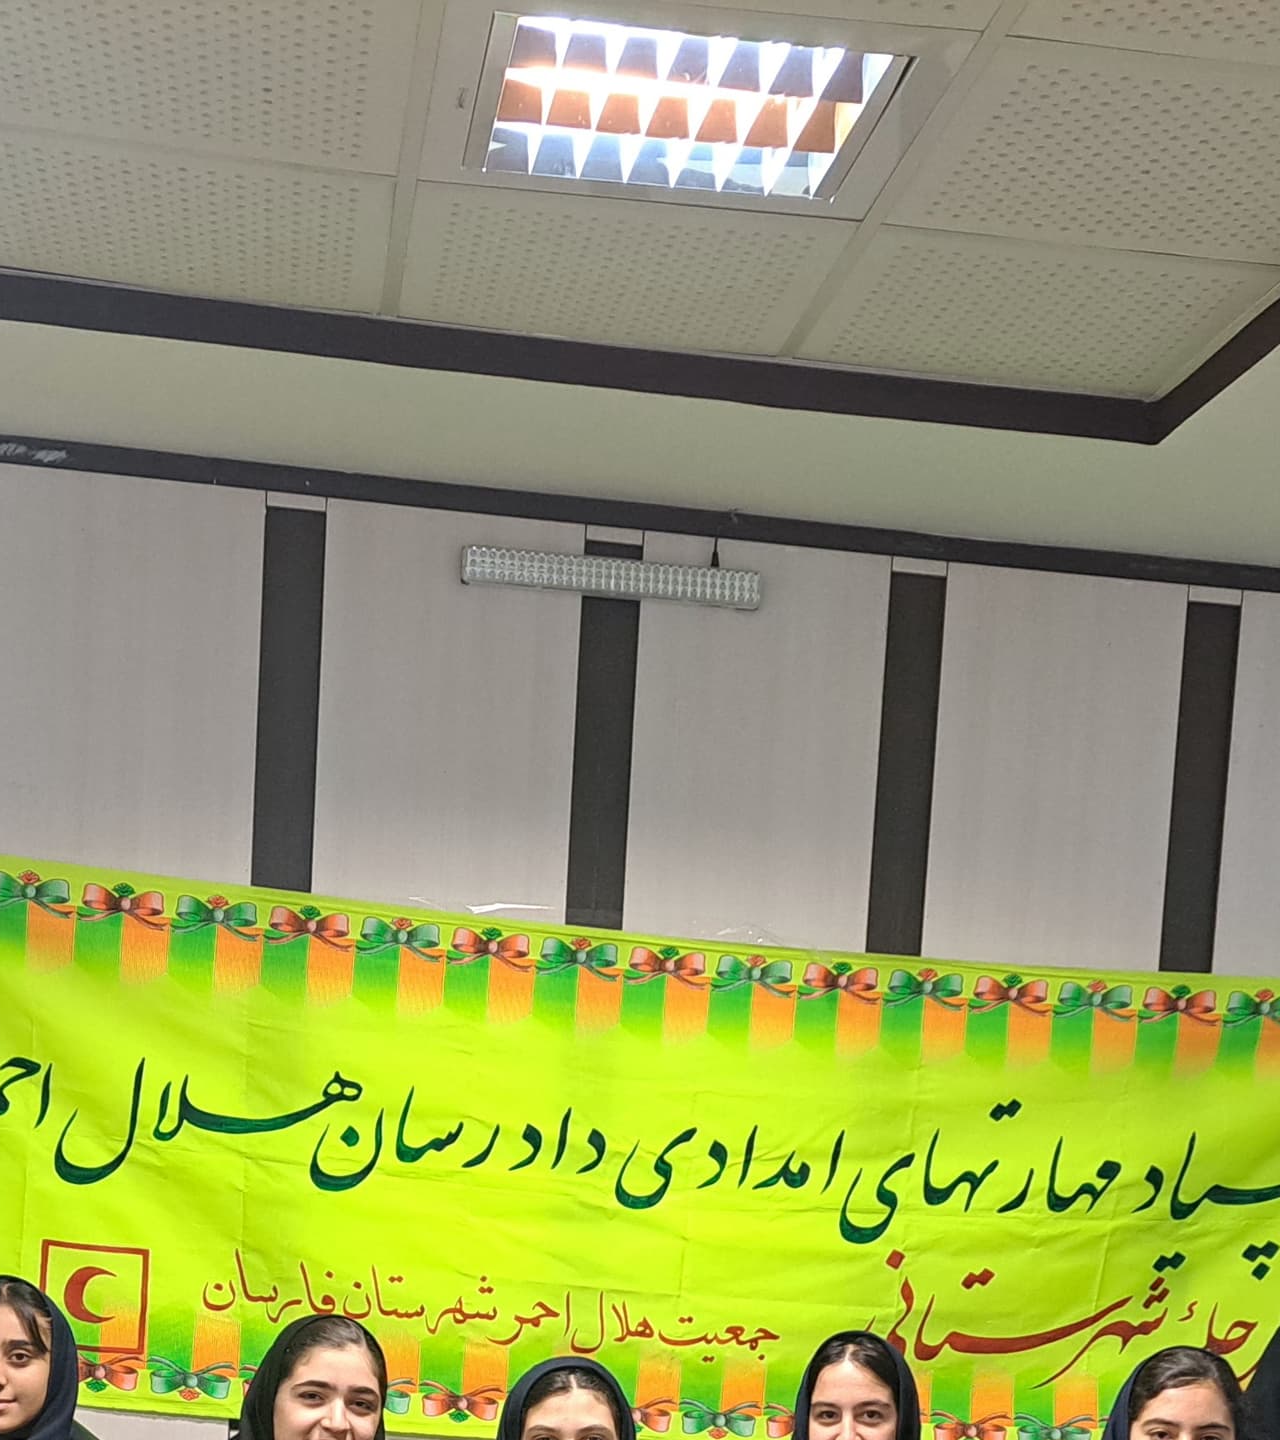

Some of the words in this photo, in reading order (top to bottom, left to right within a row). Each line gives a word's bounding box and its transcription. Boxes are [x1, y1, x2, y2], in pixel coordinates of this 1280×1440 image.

[53, 1057, 363, 1186] هلال
[308, 1085, 607, 1191] دادرسان
[614, 1124, 845, 1210] امدادی
[201, 1247, 337, 1324] فارسان
[342, 1263, 498, 1335] شهرستان
[486, 1290, 572, 1347] احمر
[570, 1289, 652, 1355] هلال
[657, 1314, 781, 1364] جمعیت
